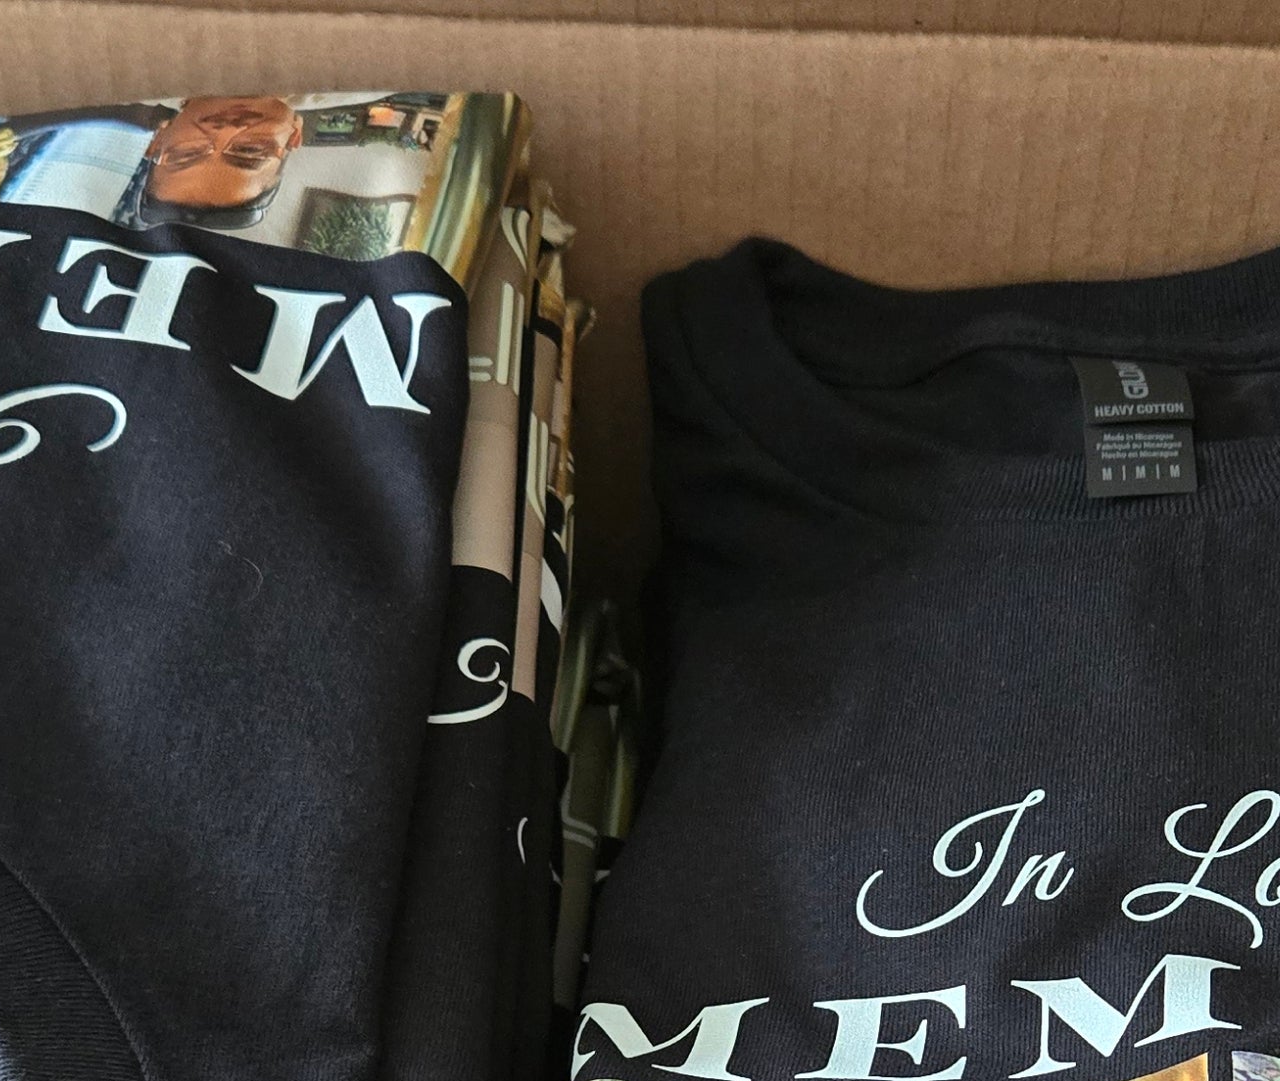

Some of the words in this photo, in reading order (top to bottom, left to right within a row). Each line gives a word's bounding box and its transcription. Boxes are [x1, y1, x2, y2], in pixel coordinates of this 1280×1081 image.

[1094, 404, 1134, 418] HEAVY
[1136, 402, 1185, 415] COTTON
[1103, 433, 1125, 442] Made
[1102, 467, 1113, 481] M
[1135, 465, 1147, 479] M
[1169, 463, 1181, 478] M
[856, 788, 1075, 938] In
